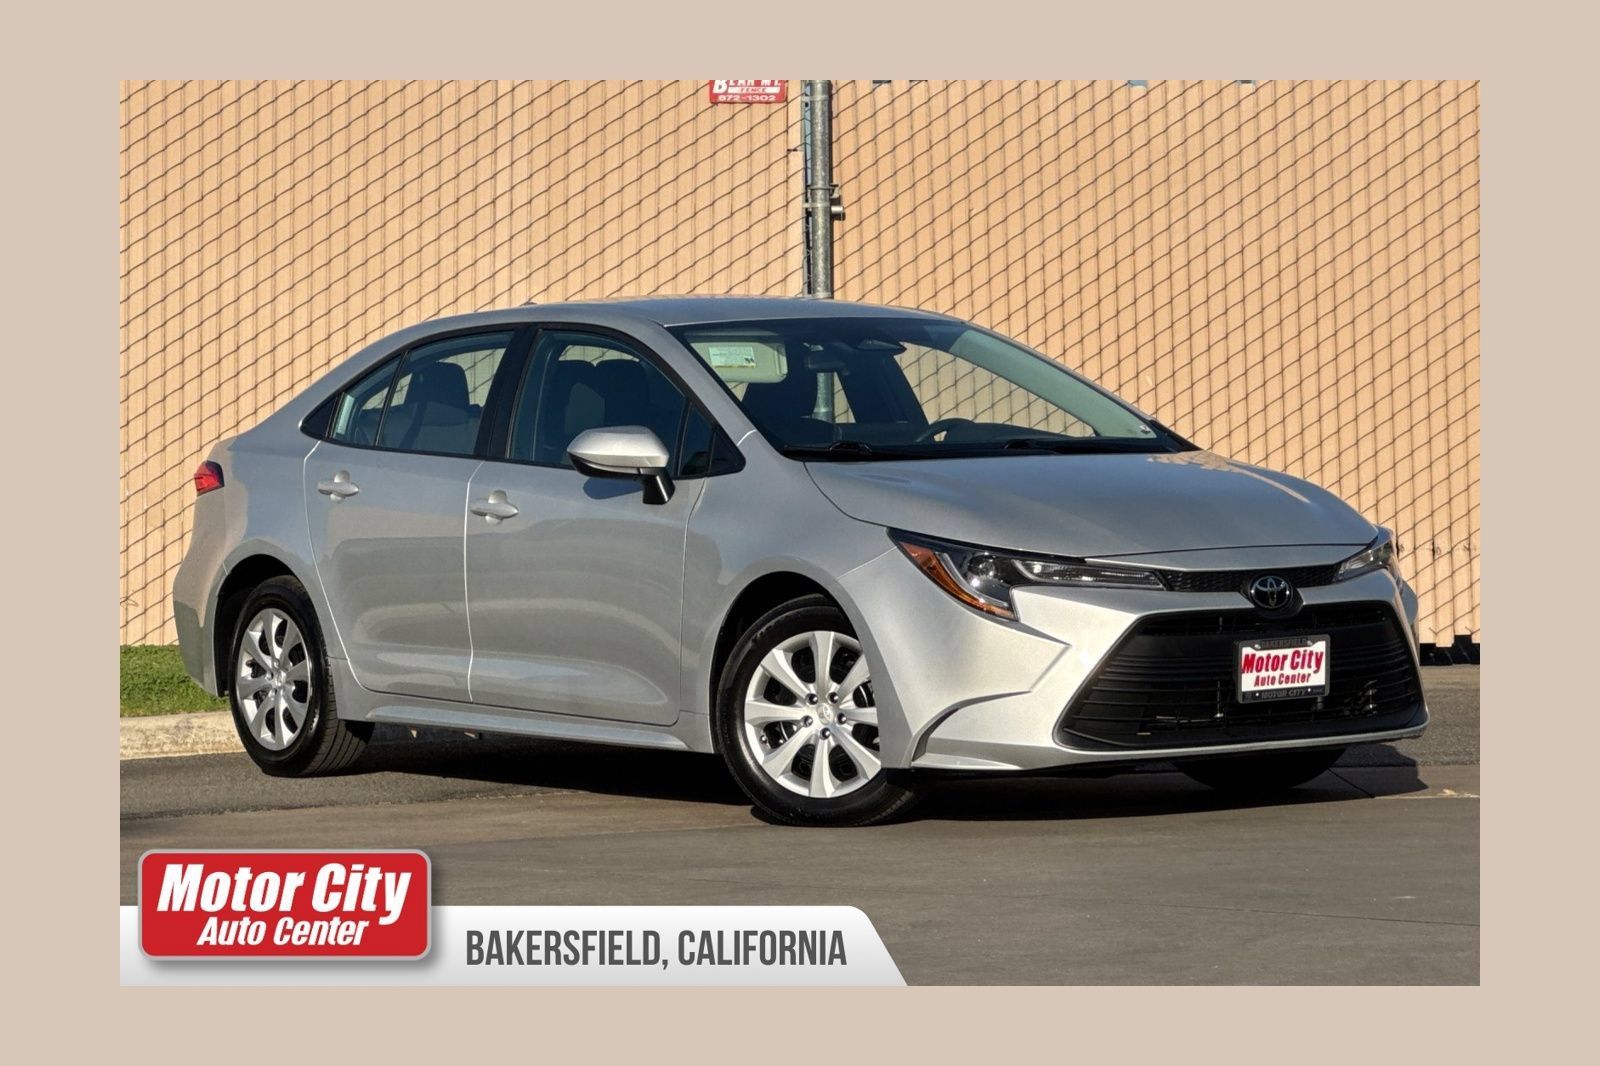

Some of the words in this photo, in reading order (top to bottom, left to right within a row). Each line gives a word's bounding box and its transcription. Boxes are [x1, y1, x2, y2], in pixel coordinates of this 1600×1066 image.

[1241, 653, 1288, 674] Motor
[1290, 650, 1324, 674] City
[1254, 675, 1276, 687] Auto
[1278, 673, 1311, 685] Center
[1261, 690, 1288, 698] MOTOR
[1289, 688, 1306, 696] CITY
